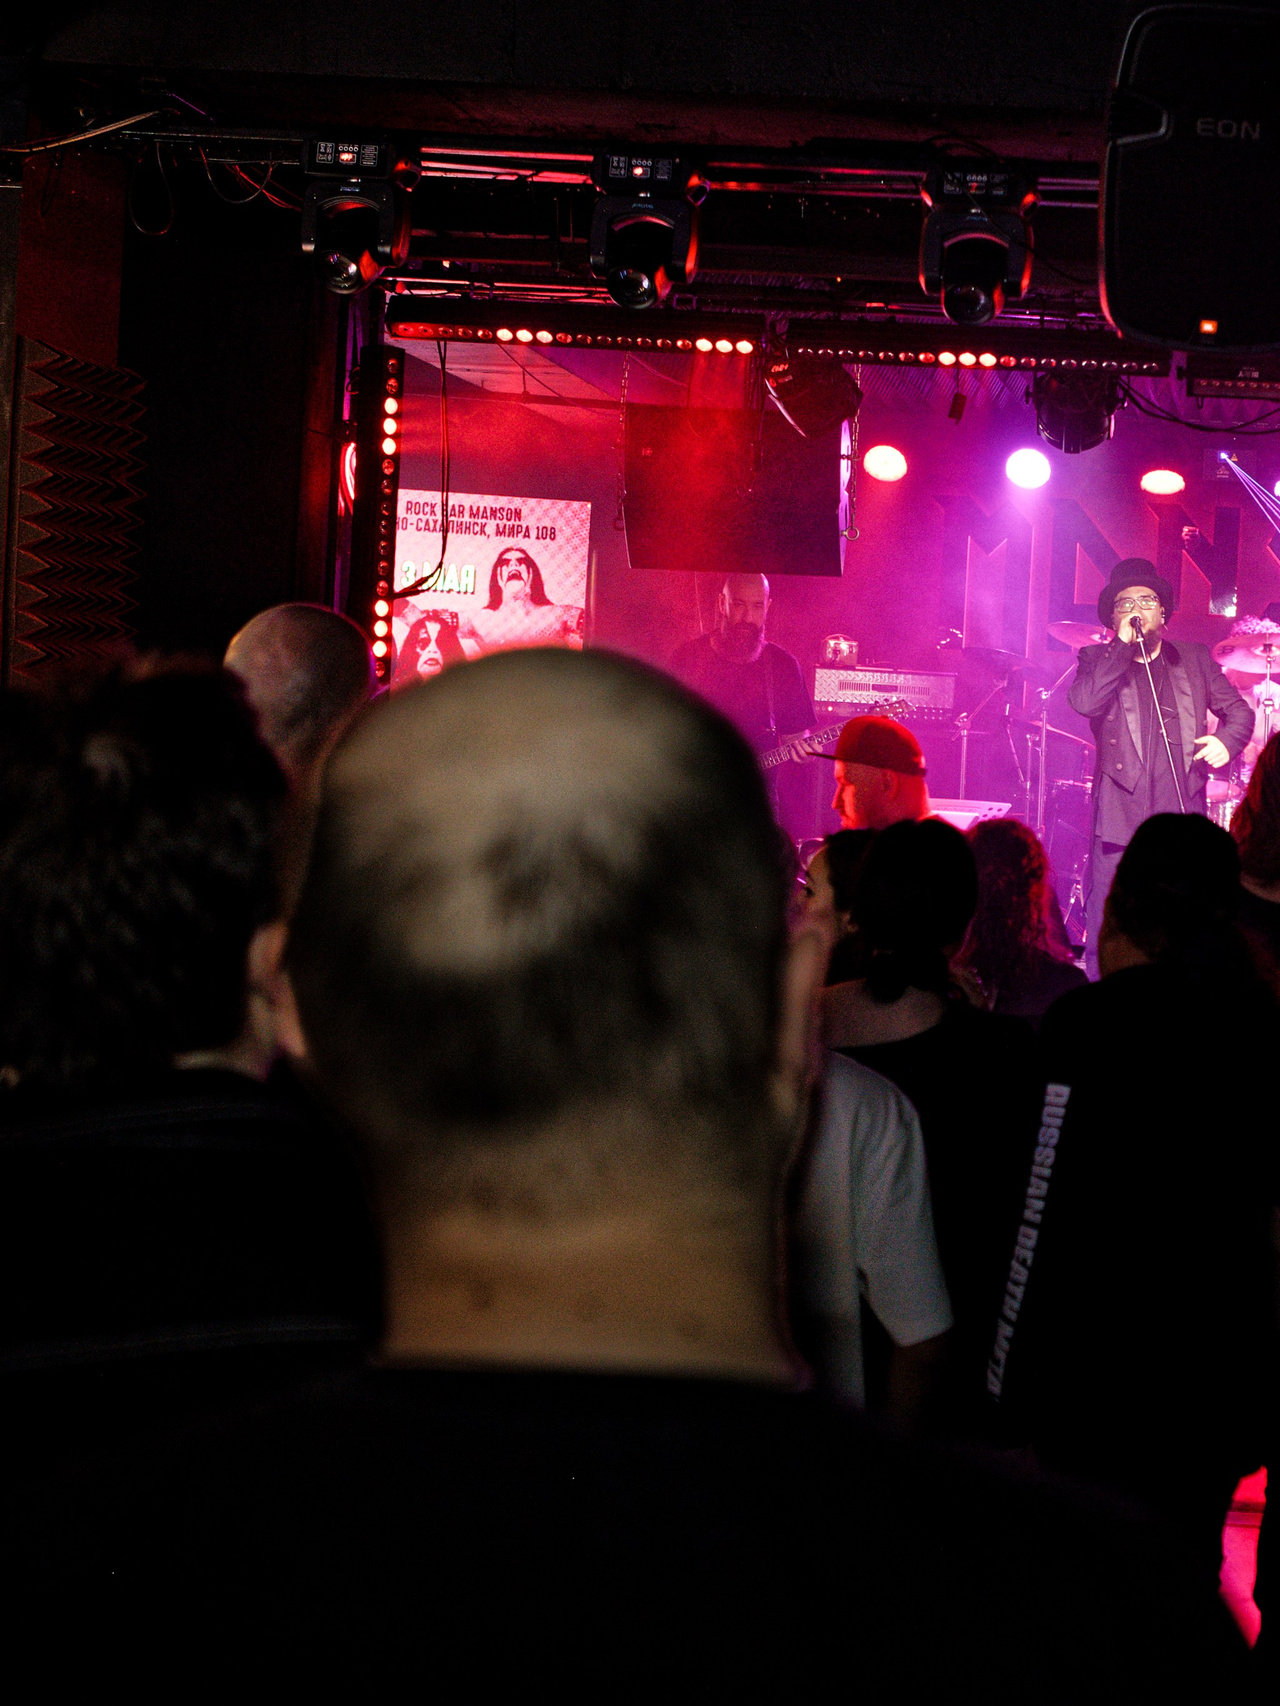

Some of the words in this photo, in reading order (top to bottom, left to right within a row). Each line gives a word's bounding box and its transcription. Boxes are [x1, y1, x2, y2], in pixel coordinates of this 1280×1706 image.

[1196, 117, 1262, 141] EON
[405, 500, 438, 517] ROCK
[441, 503, 465, 519] AR
[468, 504, 522, 522] MANSON
[495, 522, 531, 539] МИРА
[535, 525, 557, 541] 108
[401, 560, 417, 589] 3
[422, 560, 477, 595] МАЯ
[1022, 1081, 1072, 1225] RUSSIAN
